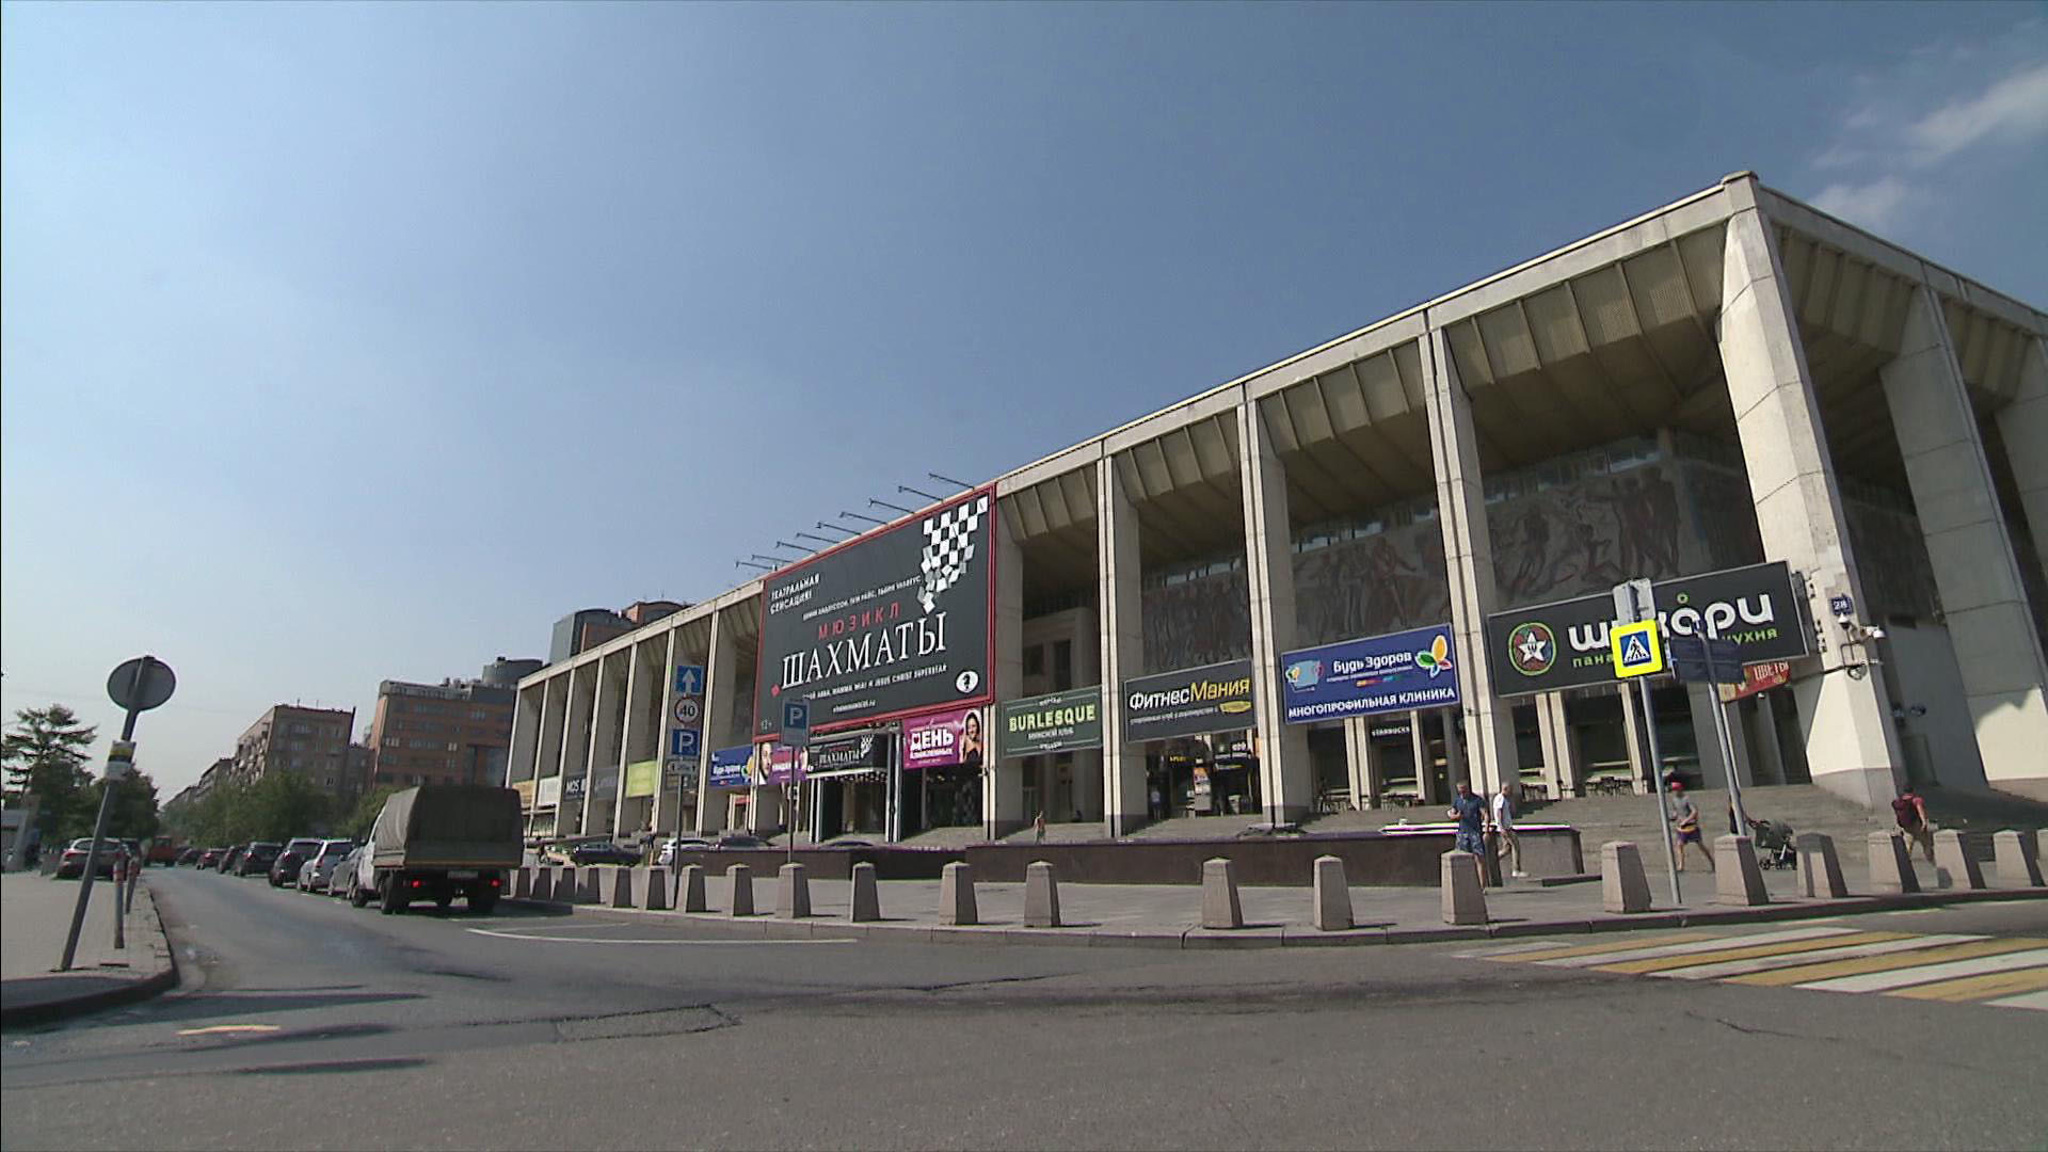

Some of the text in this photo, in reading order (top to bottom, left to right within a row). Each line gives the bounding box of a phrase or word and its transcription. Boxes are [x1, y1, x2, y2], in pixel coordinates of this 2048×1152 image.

[818, 602, 901, 640] МЮЗИКЛ
[781, 611, 948, 690] ШАХМАТЫ
[1721, 628, 1778, 645] ухня
[681, 705, 696, 717] 40
[1288, 687, 1456, 718] МНОГОПРОФИЛЬНАЯ КЛИНИКА
[1009, 704, 1096, 732] BURLESQUE
[910, 728, 955, 751] ДЕНЬ
